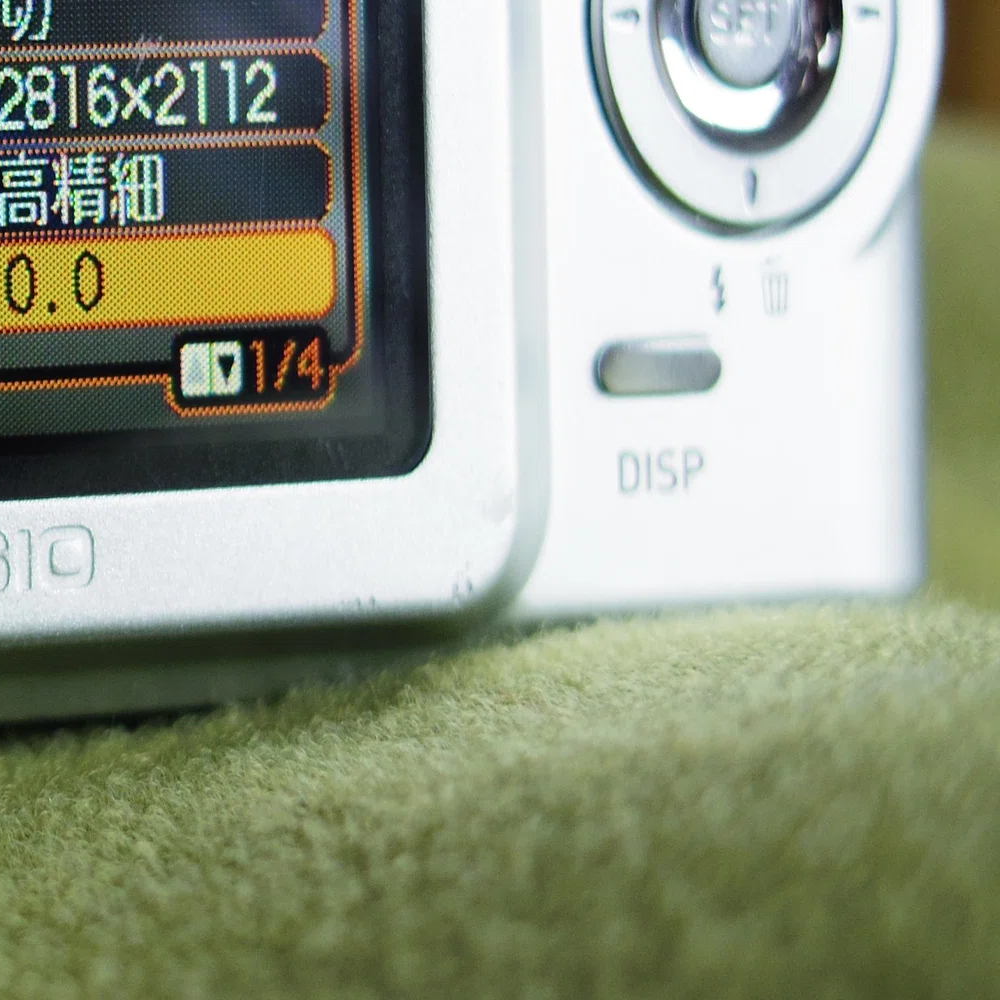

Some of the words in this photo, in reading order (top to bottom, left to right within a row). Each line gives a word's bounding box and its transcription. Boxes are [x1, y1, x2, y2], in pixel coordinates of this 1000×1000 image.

[3, 251, 105, 315] 0.0
[249, 335, 325, 394] 1/4
[617, 447, 705, 494] DISP
